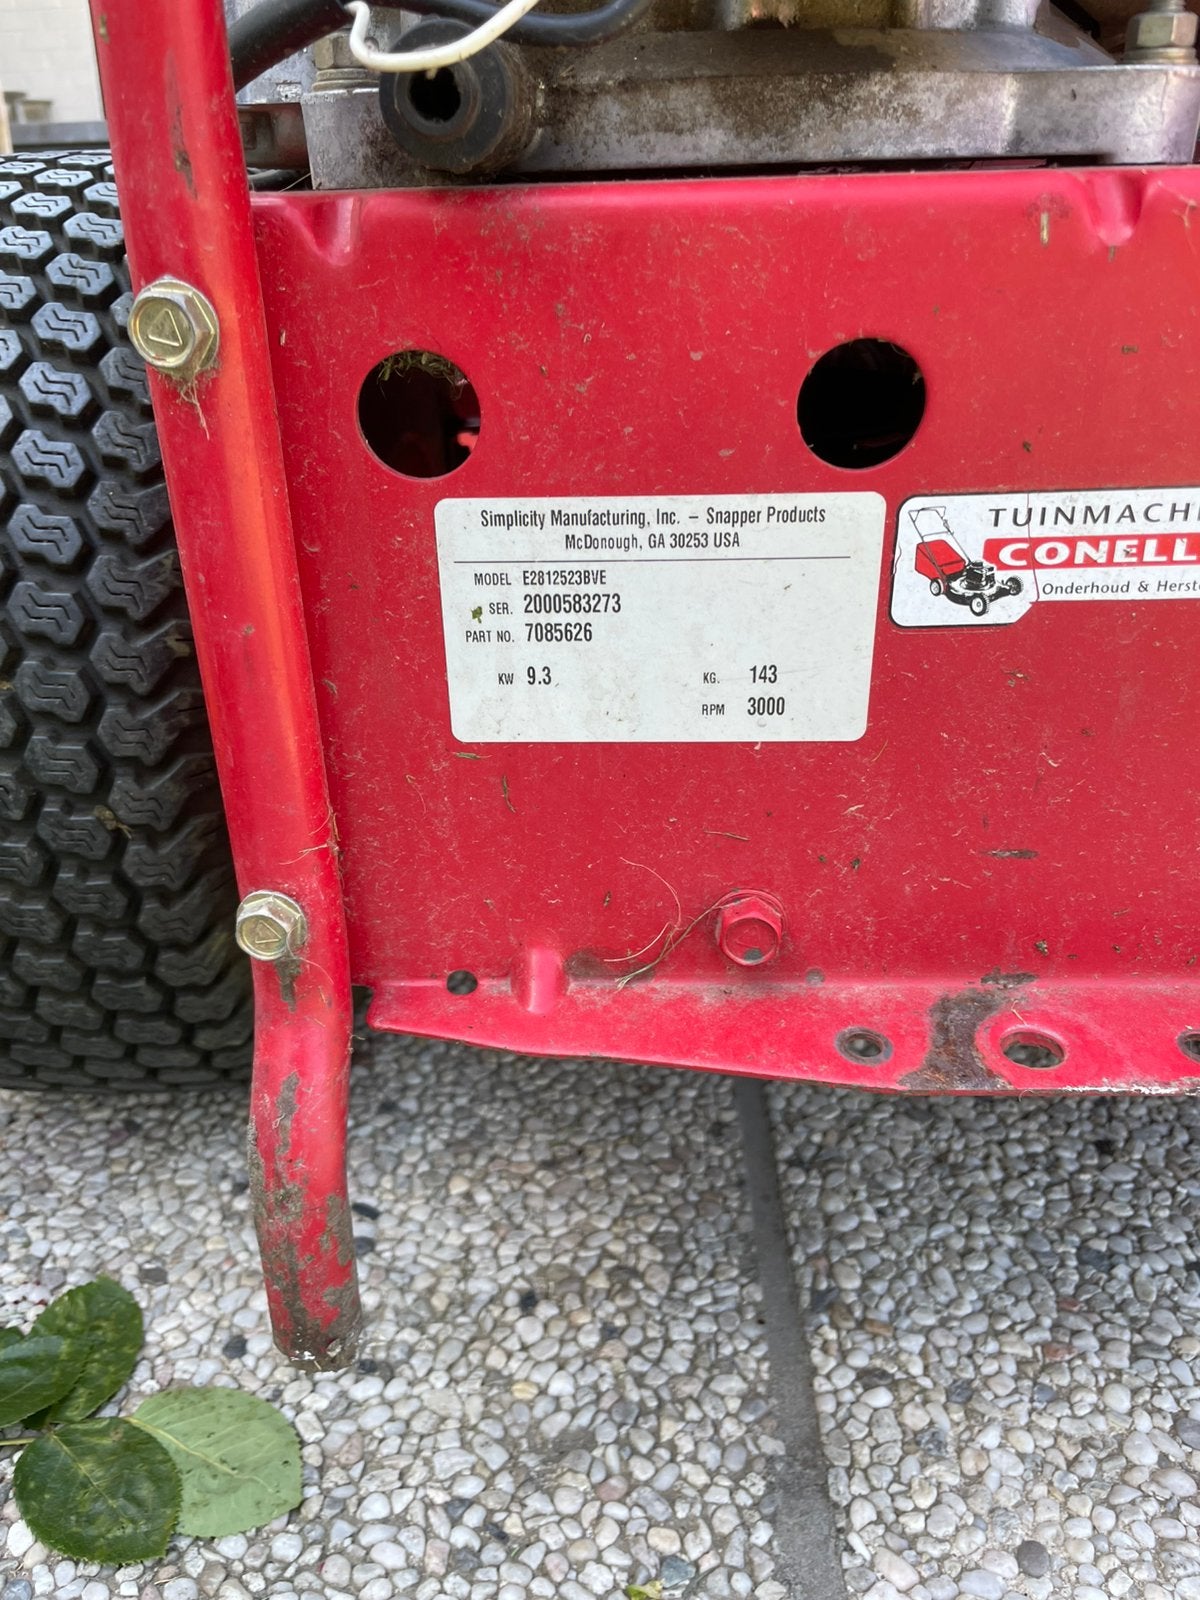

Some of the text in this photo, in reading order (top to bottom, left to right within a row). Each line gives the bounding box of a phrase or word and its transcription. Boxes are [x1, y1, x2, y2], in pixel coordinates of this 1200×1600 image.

[480, 509, 546, 531] Simplicity
[550, 508, 651, 530] Manufacturing,
[656, 507, 680, 526] Inc.
[706, 506, 762, 528] Snapper
[766, 505, 826, 524] Products
[564, 531, 740, 552] McDonough, GA 30253 USA
[473, 569, 607, 586] MODEL E2812523BVE
[1042, 580, 1200, 595] Onderhoud & Herst
[488, 592, 622, 615] SER. 2000583273
[465, 621, 593, 643] PART NO. 7085626
[497, 665, 552, 686] KW 9.3
[703, 664, 778, 684] KG. 143
[701, 696, 786, 716] RPM 3000
